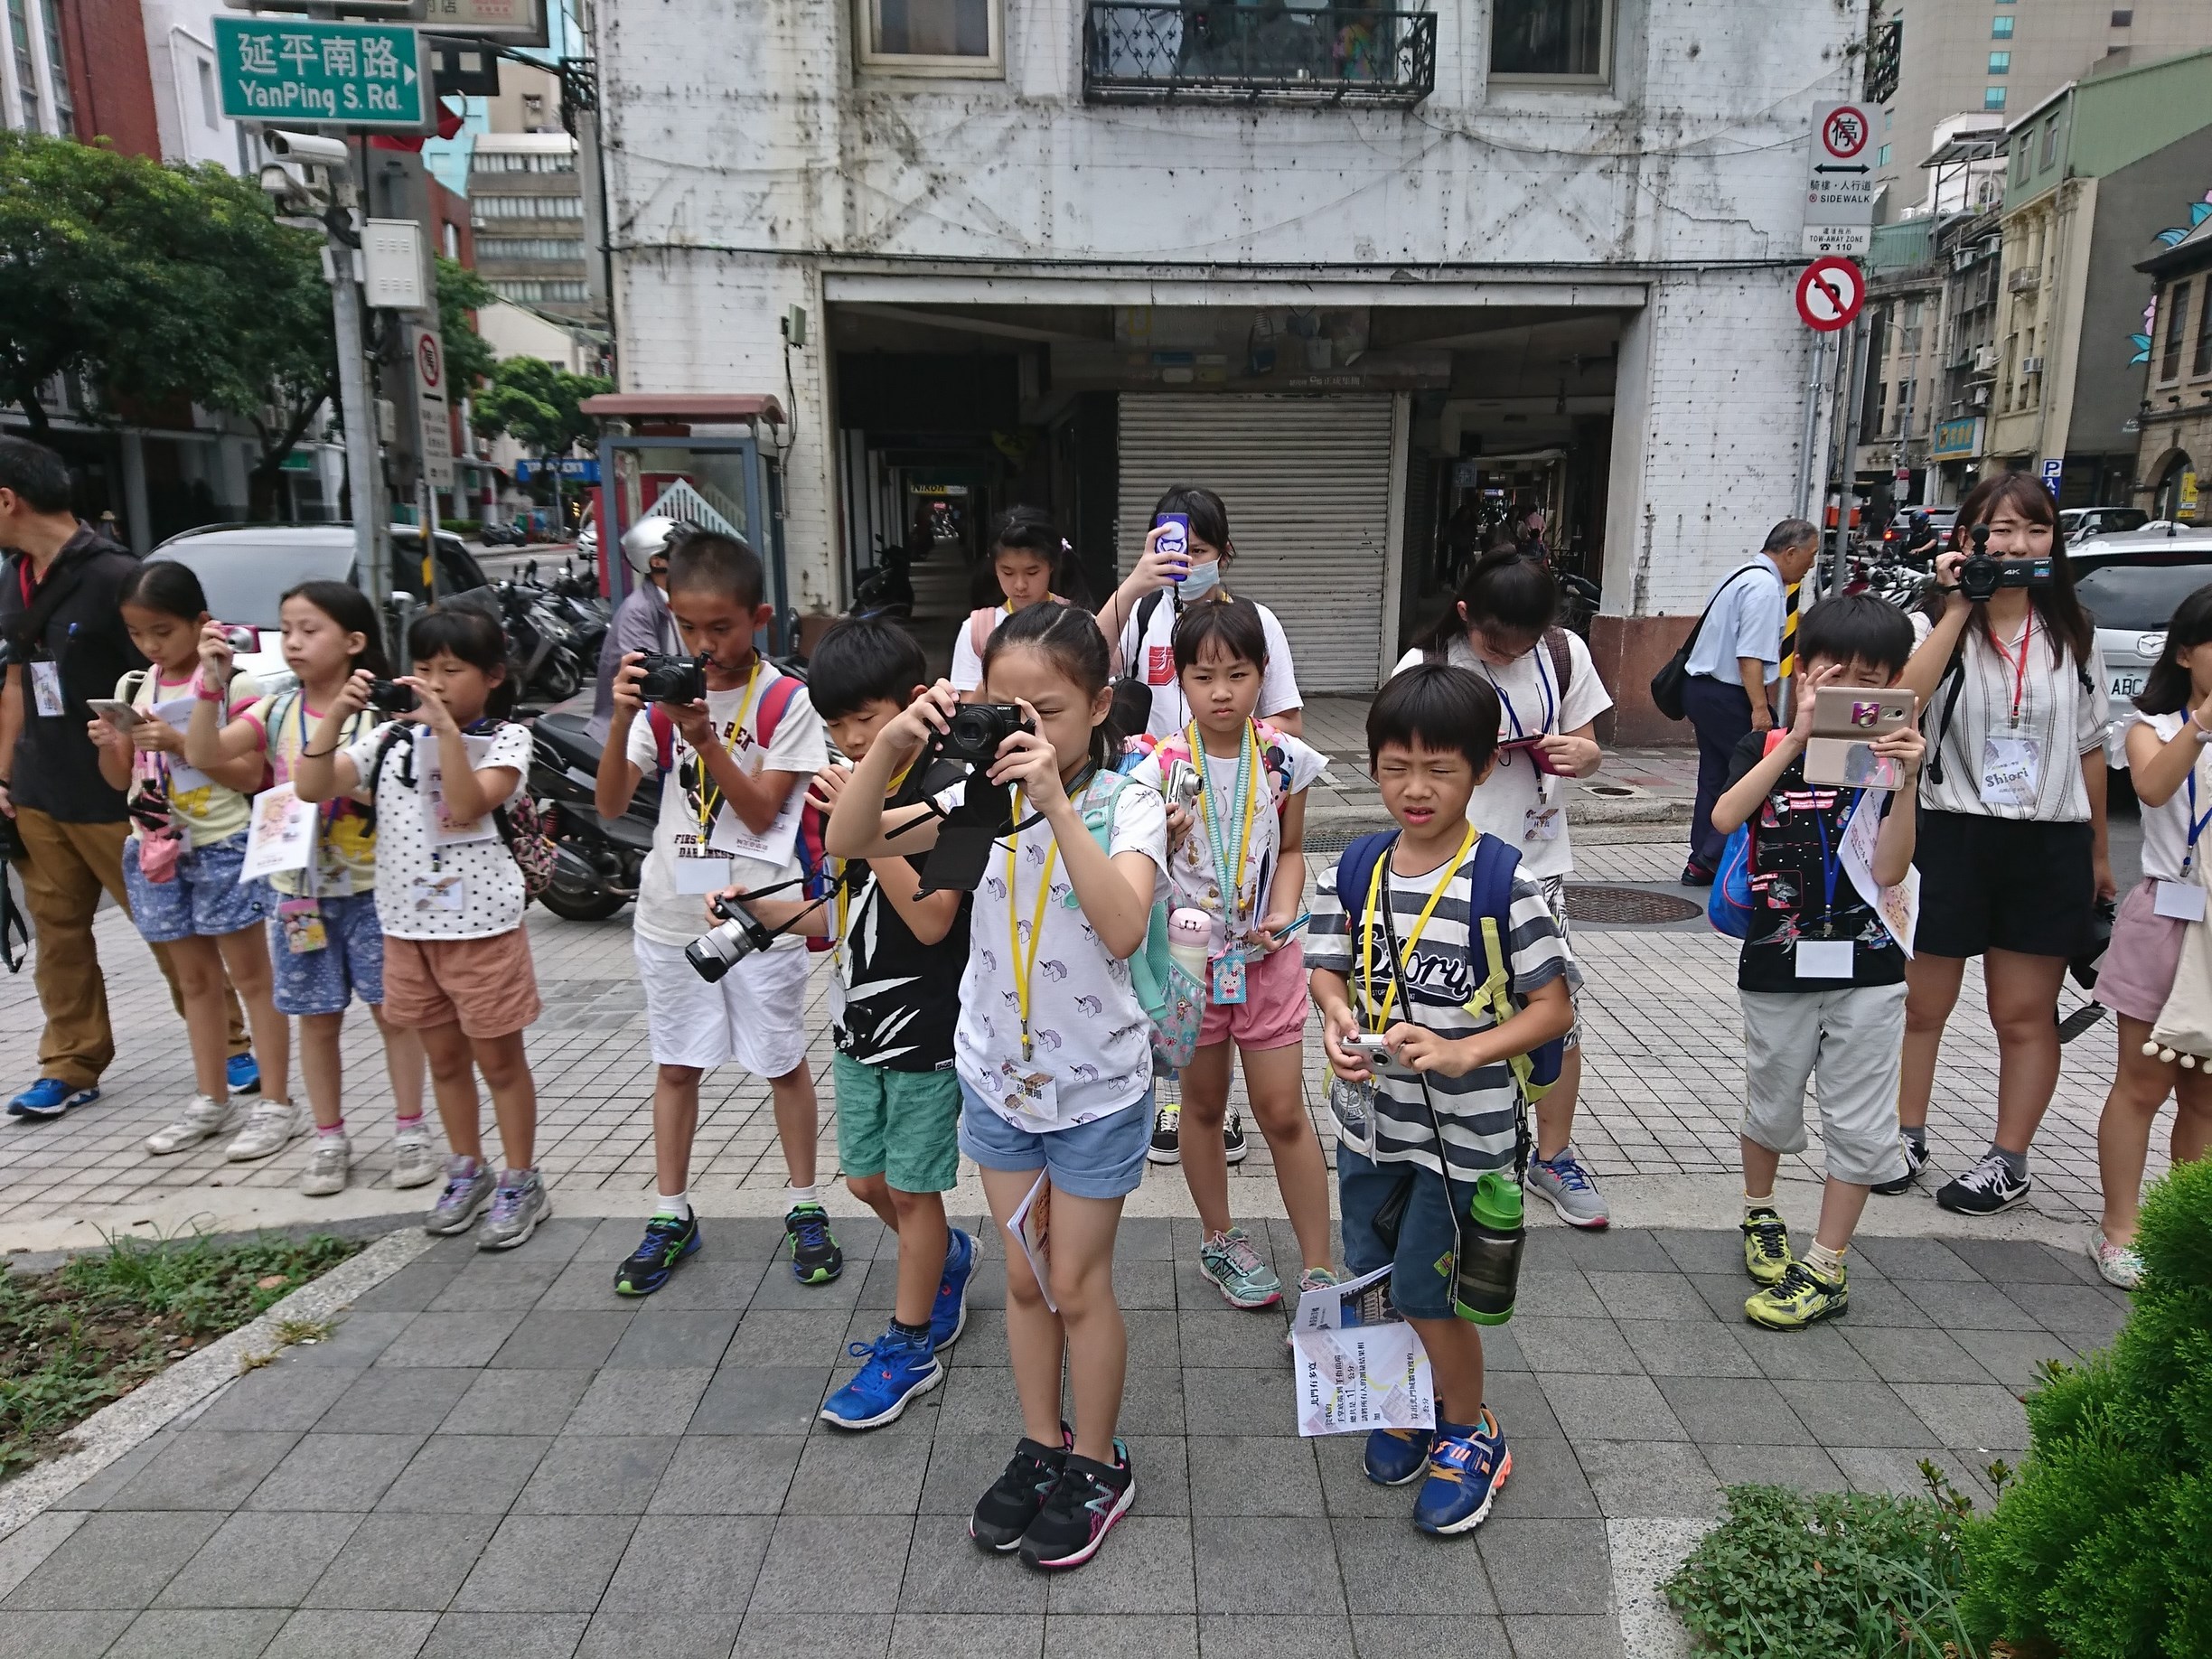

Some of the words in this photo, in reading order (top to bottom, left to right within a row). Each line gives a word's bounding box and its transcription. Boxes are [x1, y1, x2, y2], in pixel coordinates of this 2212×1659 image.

[238, 33, 398, 80] 延平南路
[239, 80, 336, 117] YanPing
[342, 84, 363, 109] S.
[367, 84, 403, 110] Rd.
[1832, 117, 1858, 146] 停
[1820, 194, 1870, 203] SIDEWALK
[1810, 235, 1844, 243] TOW-AWAY
[1836, 243, 1852, 251] 110
[2044, 461, 2060, 476] P
[1984, 767, 2029, 788] Shiori
[674, 834, 698, 845] FIRS
